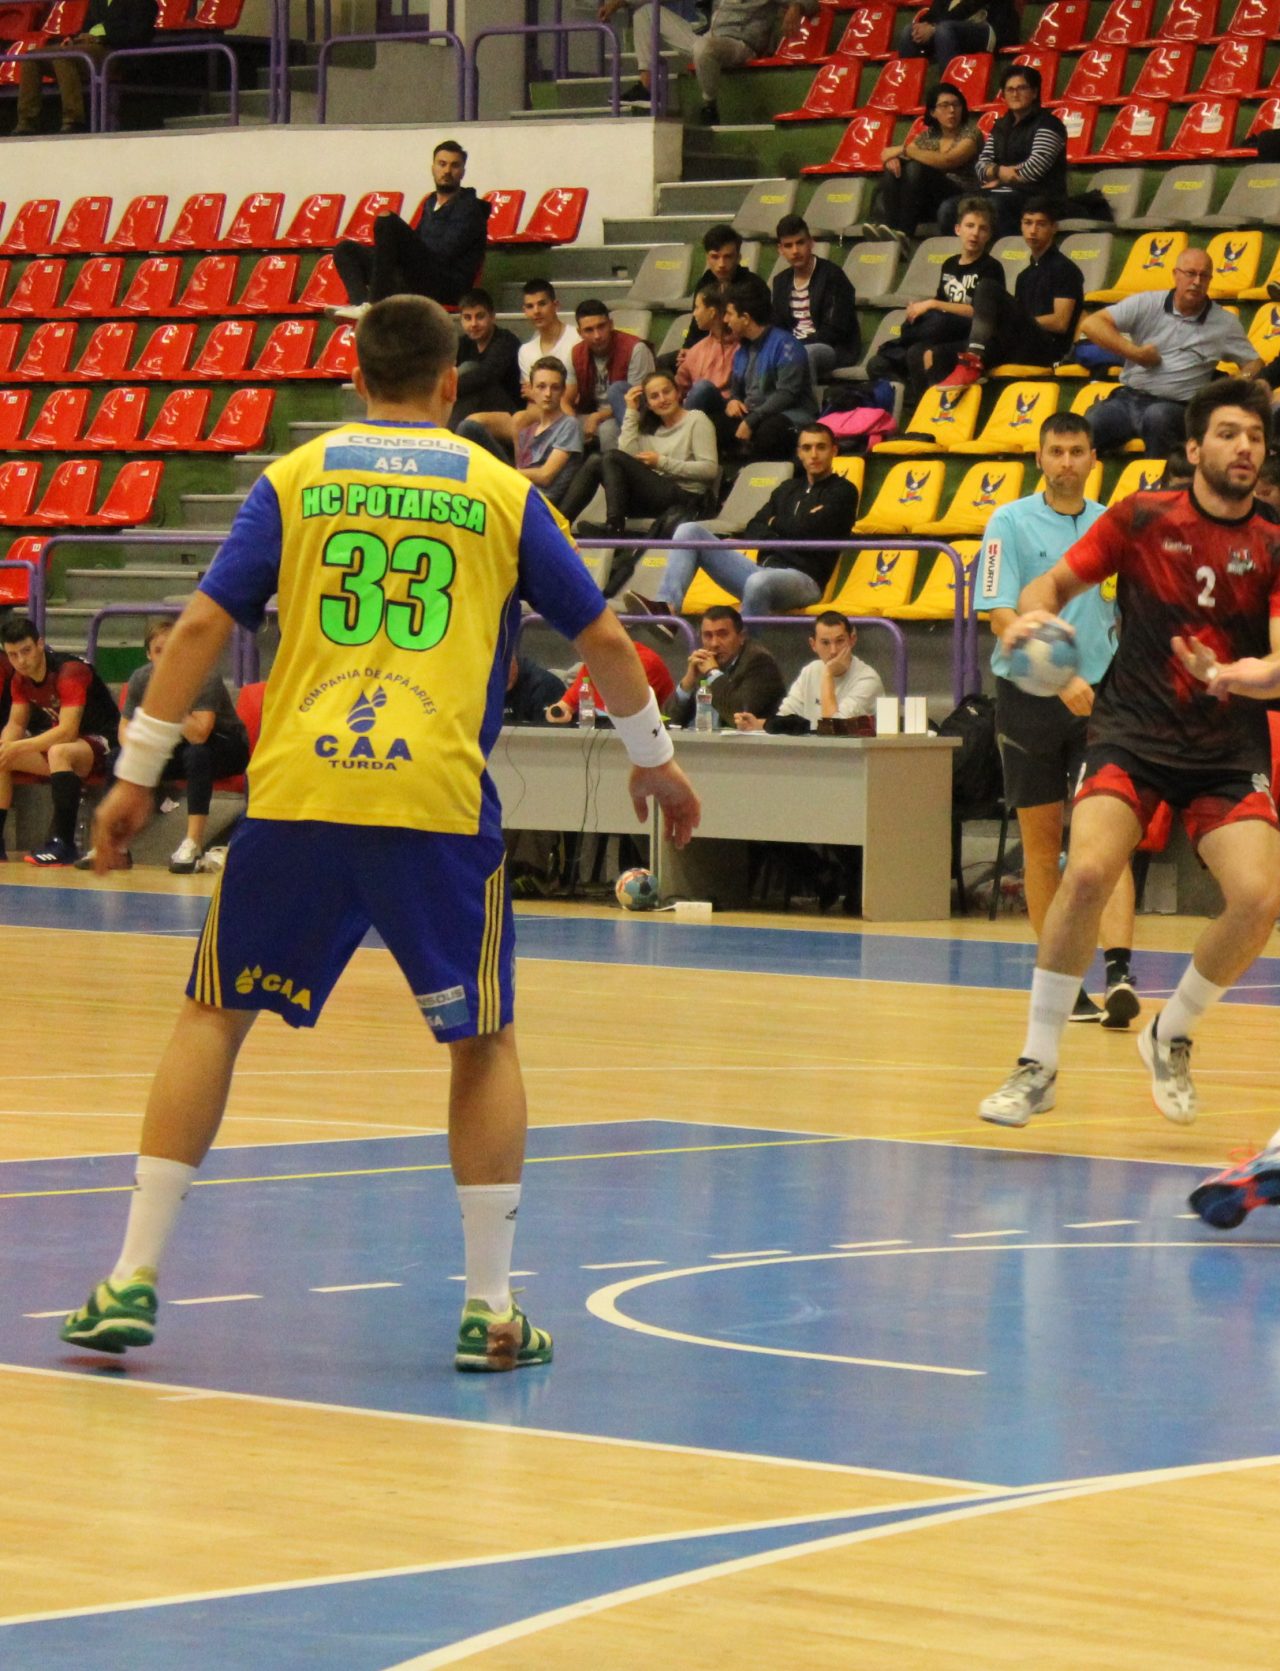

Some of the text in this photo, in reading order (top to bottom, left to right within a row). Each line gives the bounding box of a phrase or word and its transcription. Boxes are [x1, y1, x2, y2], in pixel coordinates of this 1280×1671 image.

[347, 434, 469, 454] CONSOLIS
[374, 456, 419, 473] ASA
[302, 483, 487, 537] HC POTAISSA
[319, 529, 457, 652] 33
[1195, 565, 1216, 608] 2
[364, 667, 383, 679] DE
[314, 734, 413, 762] CAA
[328, 759, 398, 772] TURDA
[262, 973, 311, 1011] CAA
